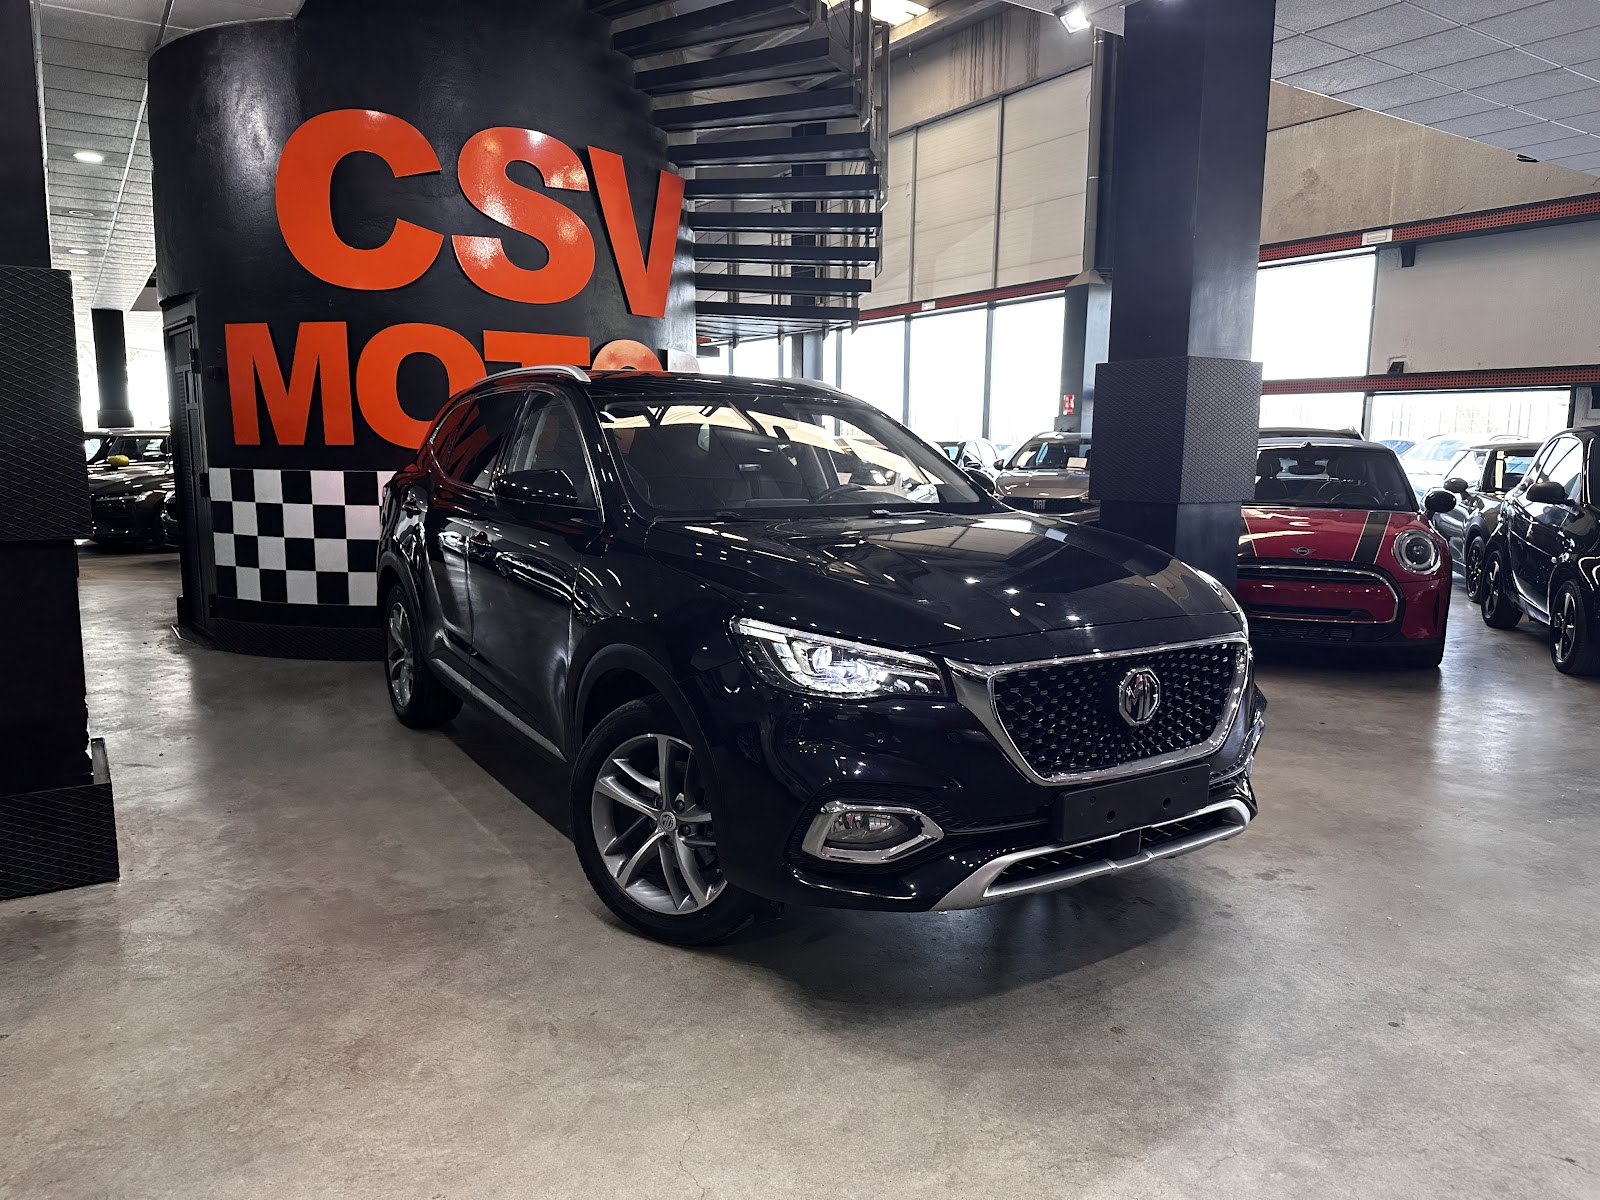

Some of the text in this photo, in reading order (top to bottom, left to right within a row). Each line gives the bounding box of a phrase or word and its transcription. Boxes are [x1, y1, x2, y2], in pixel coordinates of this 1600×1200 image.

[275, 108, 686, 318] CSV
[1033, 499, 1047, 510] FIAT
[1124, 672, 1158, 721] MG
